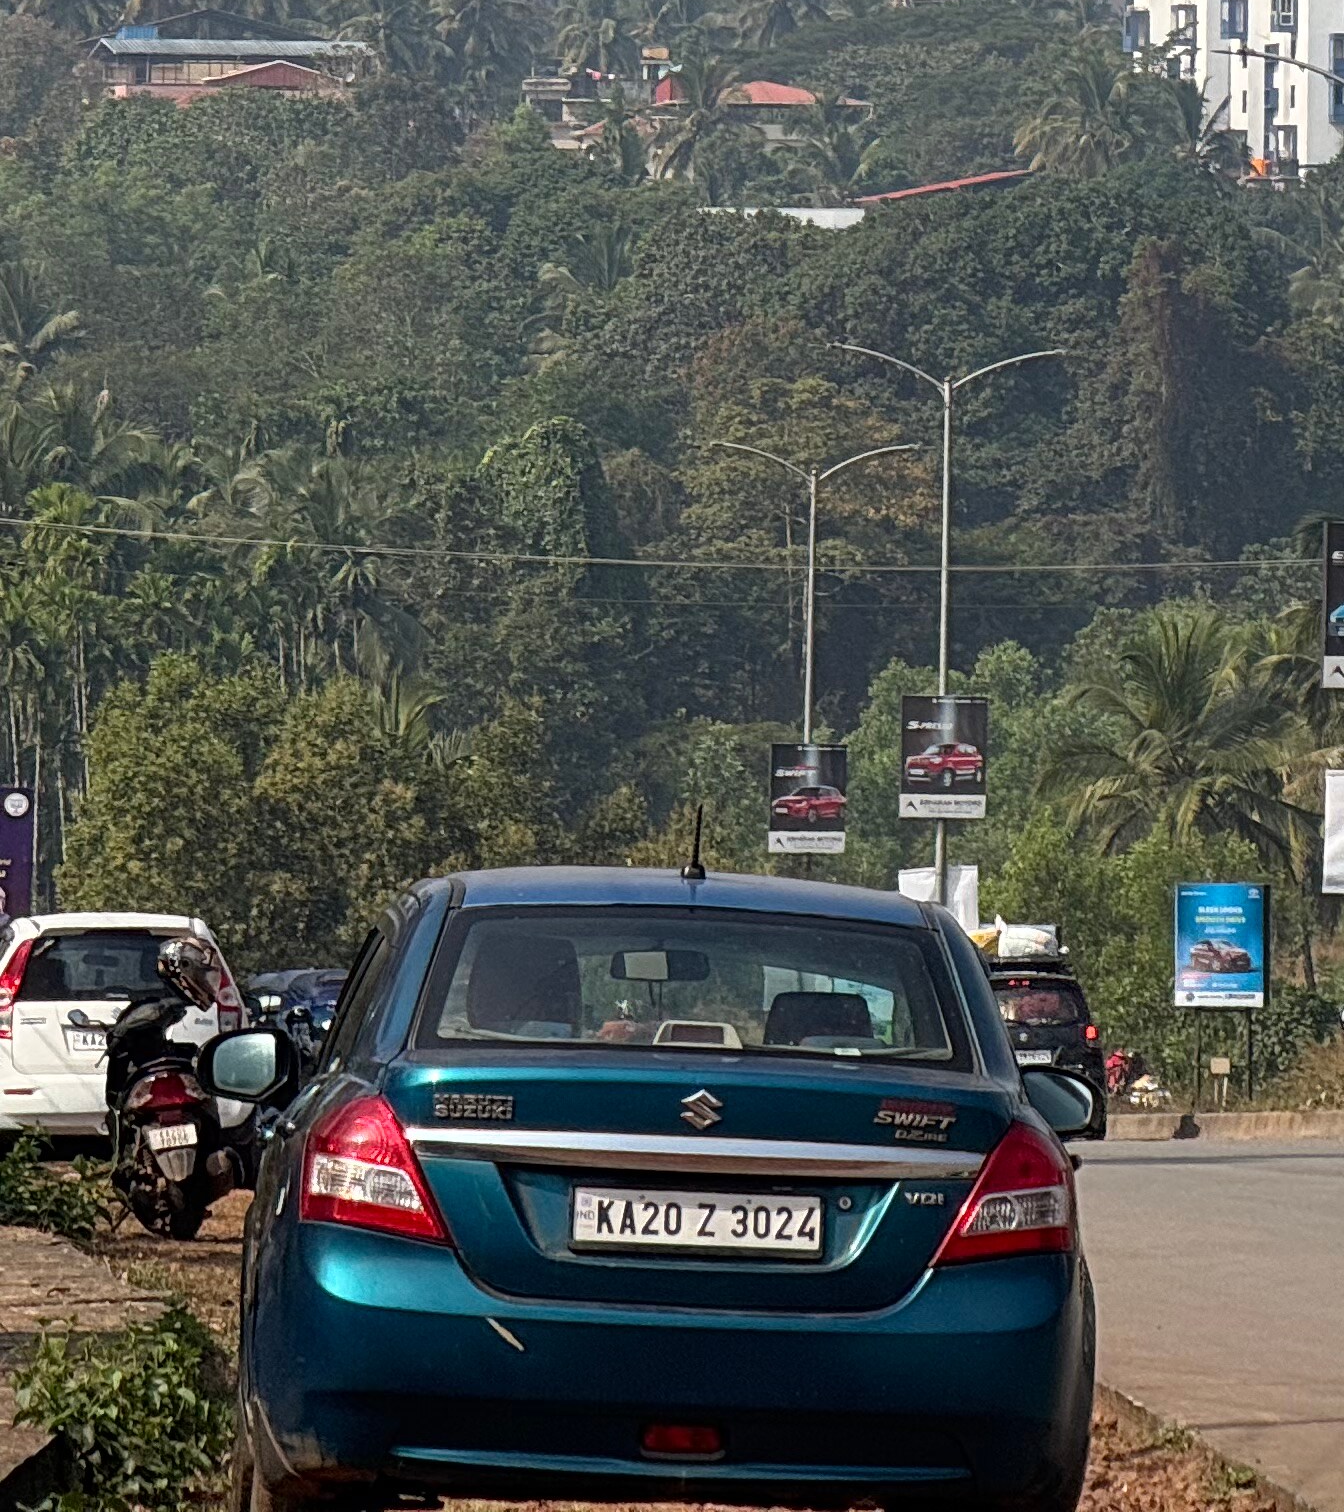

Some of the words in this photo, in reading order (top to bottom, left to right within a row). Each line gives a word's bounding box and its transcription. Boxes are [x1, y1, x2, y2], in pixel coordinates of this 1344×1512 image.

[434, 1104, 513, 1120] SUZUKI
[873, 1110, 957, 1130] SWIFT
[894, 1129, 949, 1142] DZIRE
[596, 1198, 682, 1237] KA20
[696, 1202, 717, 1238] Z
[730, 1205, 816, 1242] 3024
